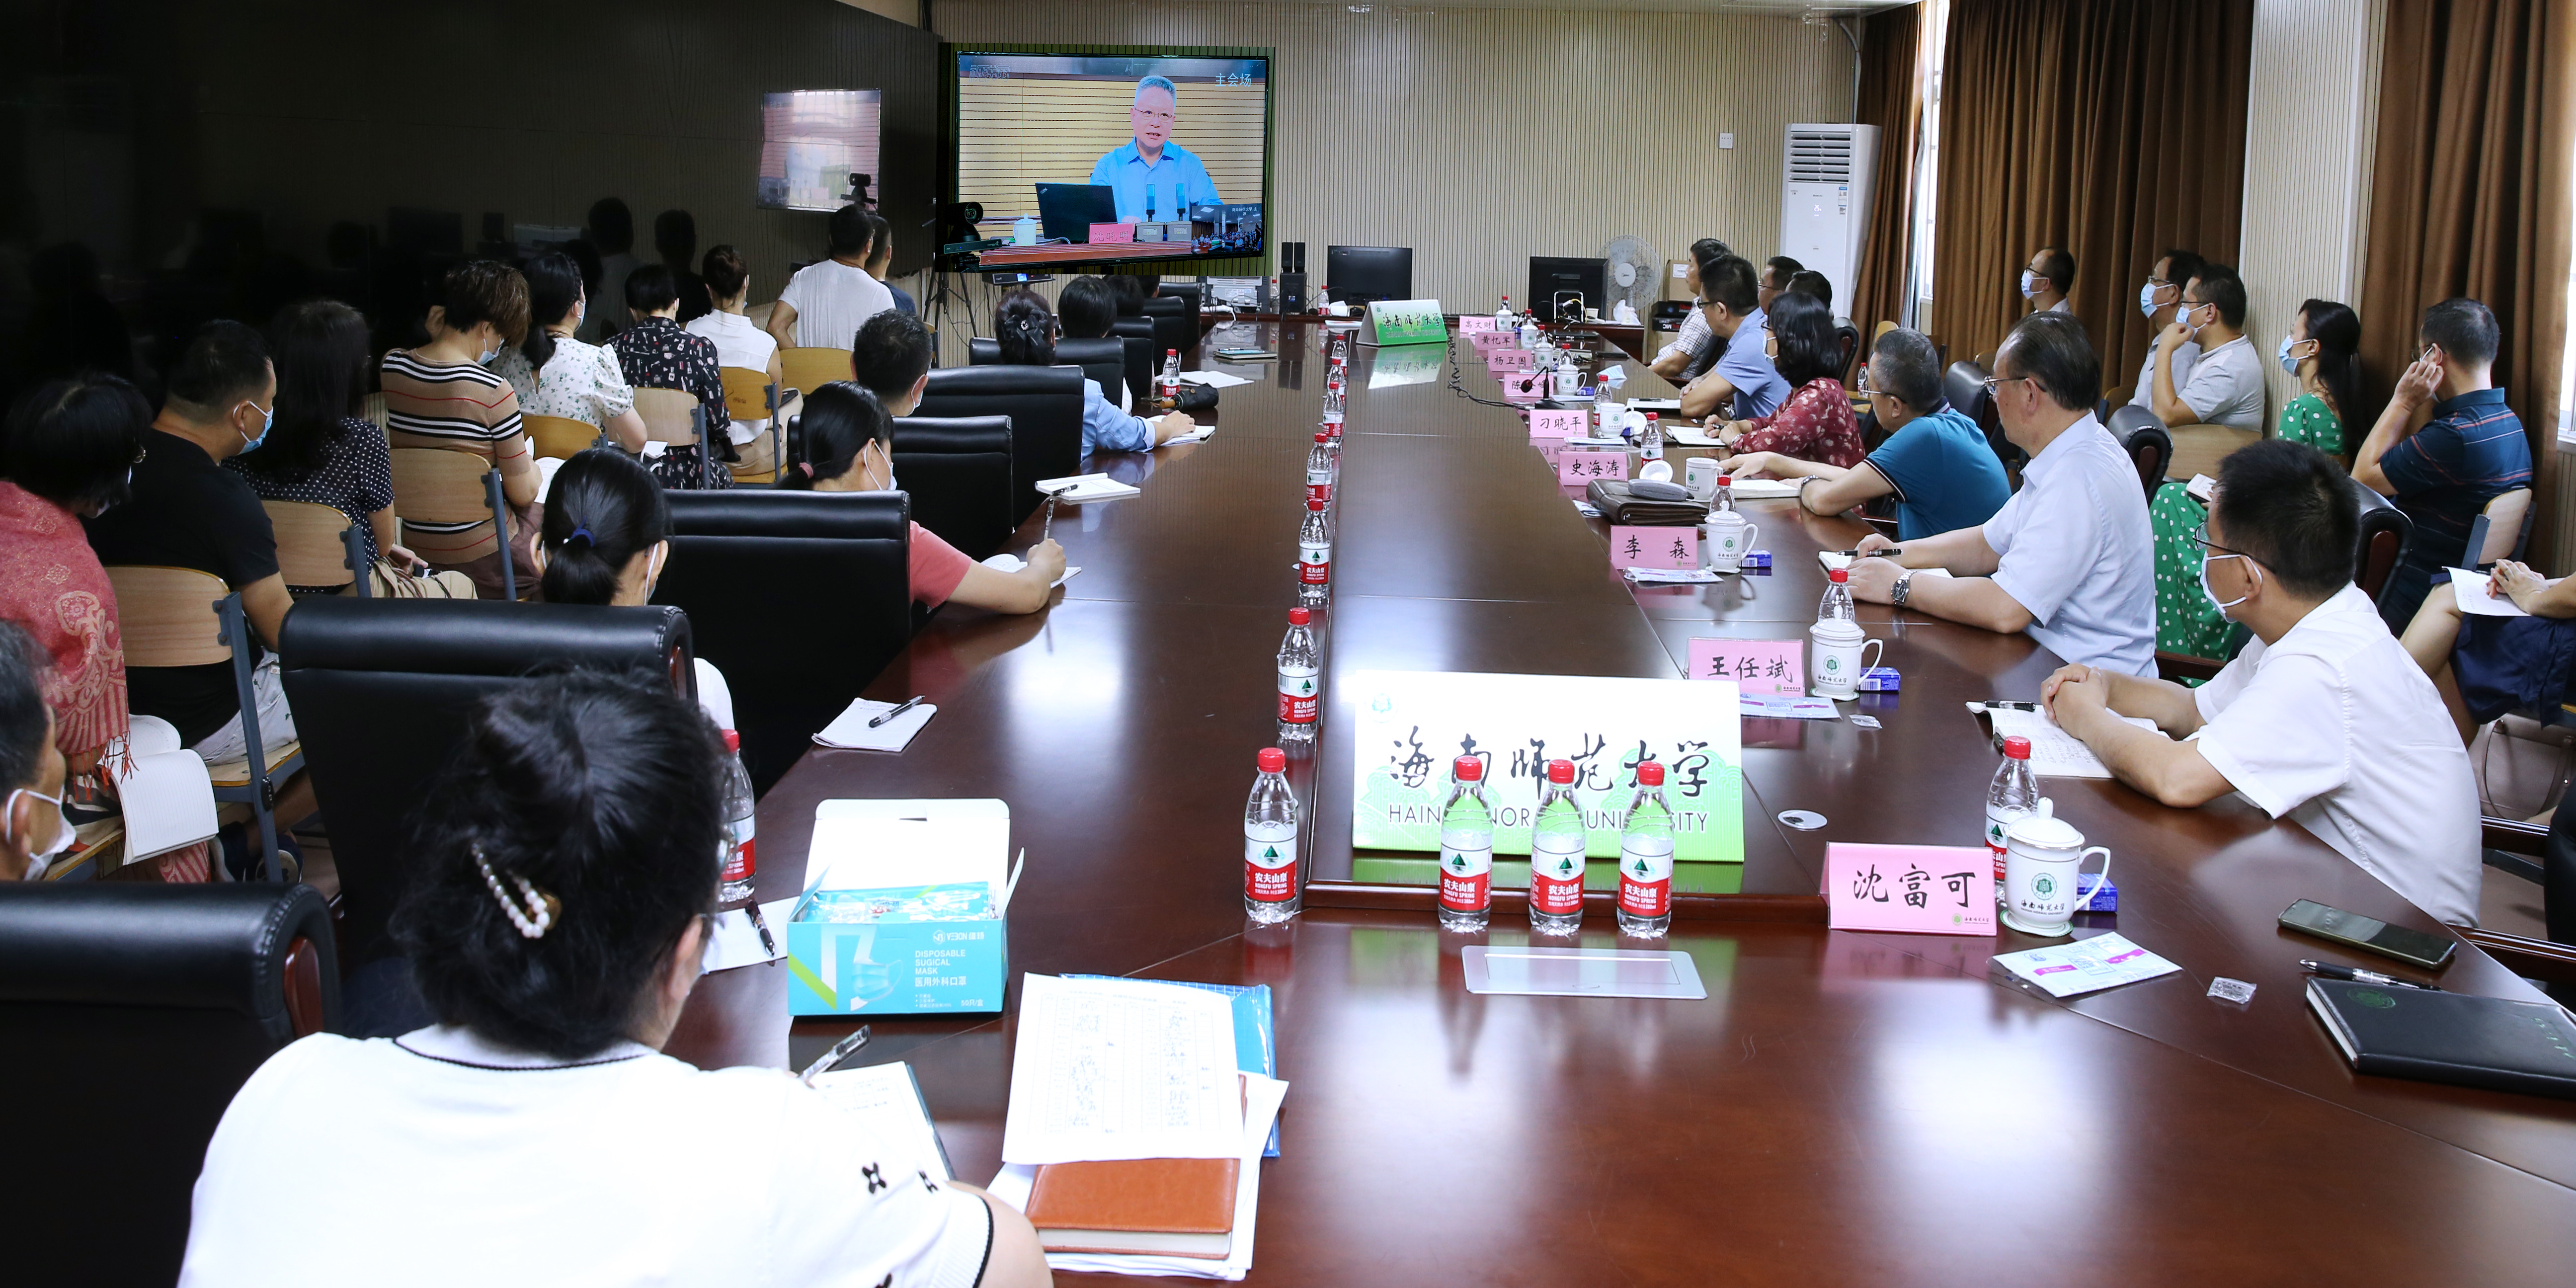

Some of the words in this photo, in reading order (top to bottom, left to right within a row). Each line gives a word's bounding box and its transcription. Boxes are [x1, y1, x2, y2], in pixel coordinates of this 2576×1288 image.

[968, 65, 1011, 82] 视联网
[1215, 73, 1251, 87] 主会场
[1093, 230, 1128, 242] 沈晓明
[1383, 312, 1440, 328] 海南师范大学
[1465, 320, 1491, 329] 高文财
[1481, 335, 1511, 346] 黄忆军
[1494, 355, 1526, 366] 杨卫国
[1540, 416, 1581, 431] 刁晓平
[1570, 459, 1619, 477] 史海涛
[1707, 654, 1793, 683] 王任斌
[1294, 700, 1316, 709] 农夫山泉
[1390, 725, 1709, 797] 海南师范大学
[1255, 872, 1287, 883] 农夫山泉
[1444, 878, 1476, 892] 农夫山泉
[1548, 883, 1579, 895] 农夫山泉
[1625, 883, 1657, 897] 农夫山泉
[1853, 863, 1976, 909] 沈富可
[1444, 888, 1458, 897] NONGFU
[1624, 893, 1639, 902] NONGFU
[2021, 899, 2065, 911] 海南师范大学
[915, 950, 966, 958] DISPOSABLE
[915, 975, 966, 987] 医用外科口罩
[961, 998, 983, 1007] 50只/盒
